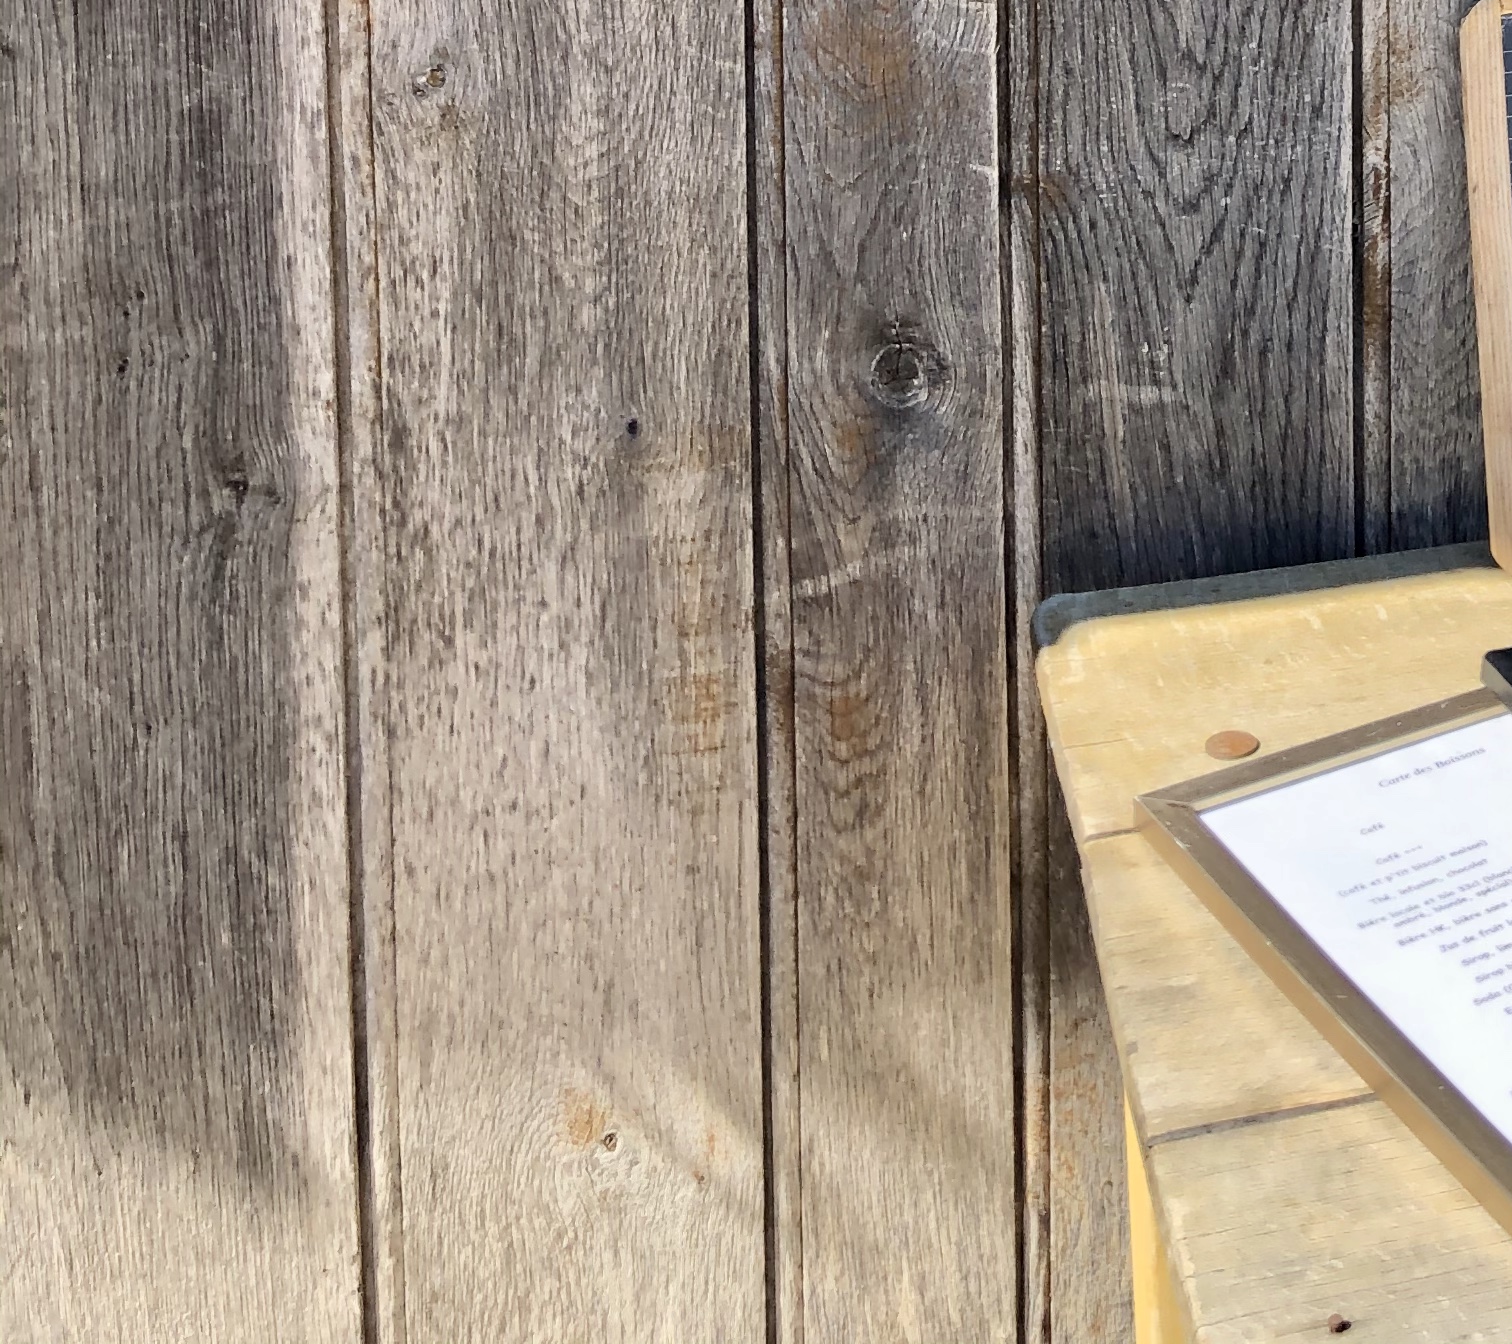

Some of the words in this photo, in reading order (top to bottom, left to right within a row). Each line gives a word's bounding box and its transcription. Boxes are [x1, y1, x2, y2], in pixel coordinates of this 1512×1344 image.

[1378, 771, 1411, 788] Carte
[1414, 765, 1433, 777] des
[1435, 748, 1487, 769] Boissons
[1360, 822, 1385, 836] Café
